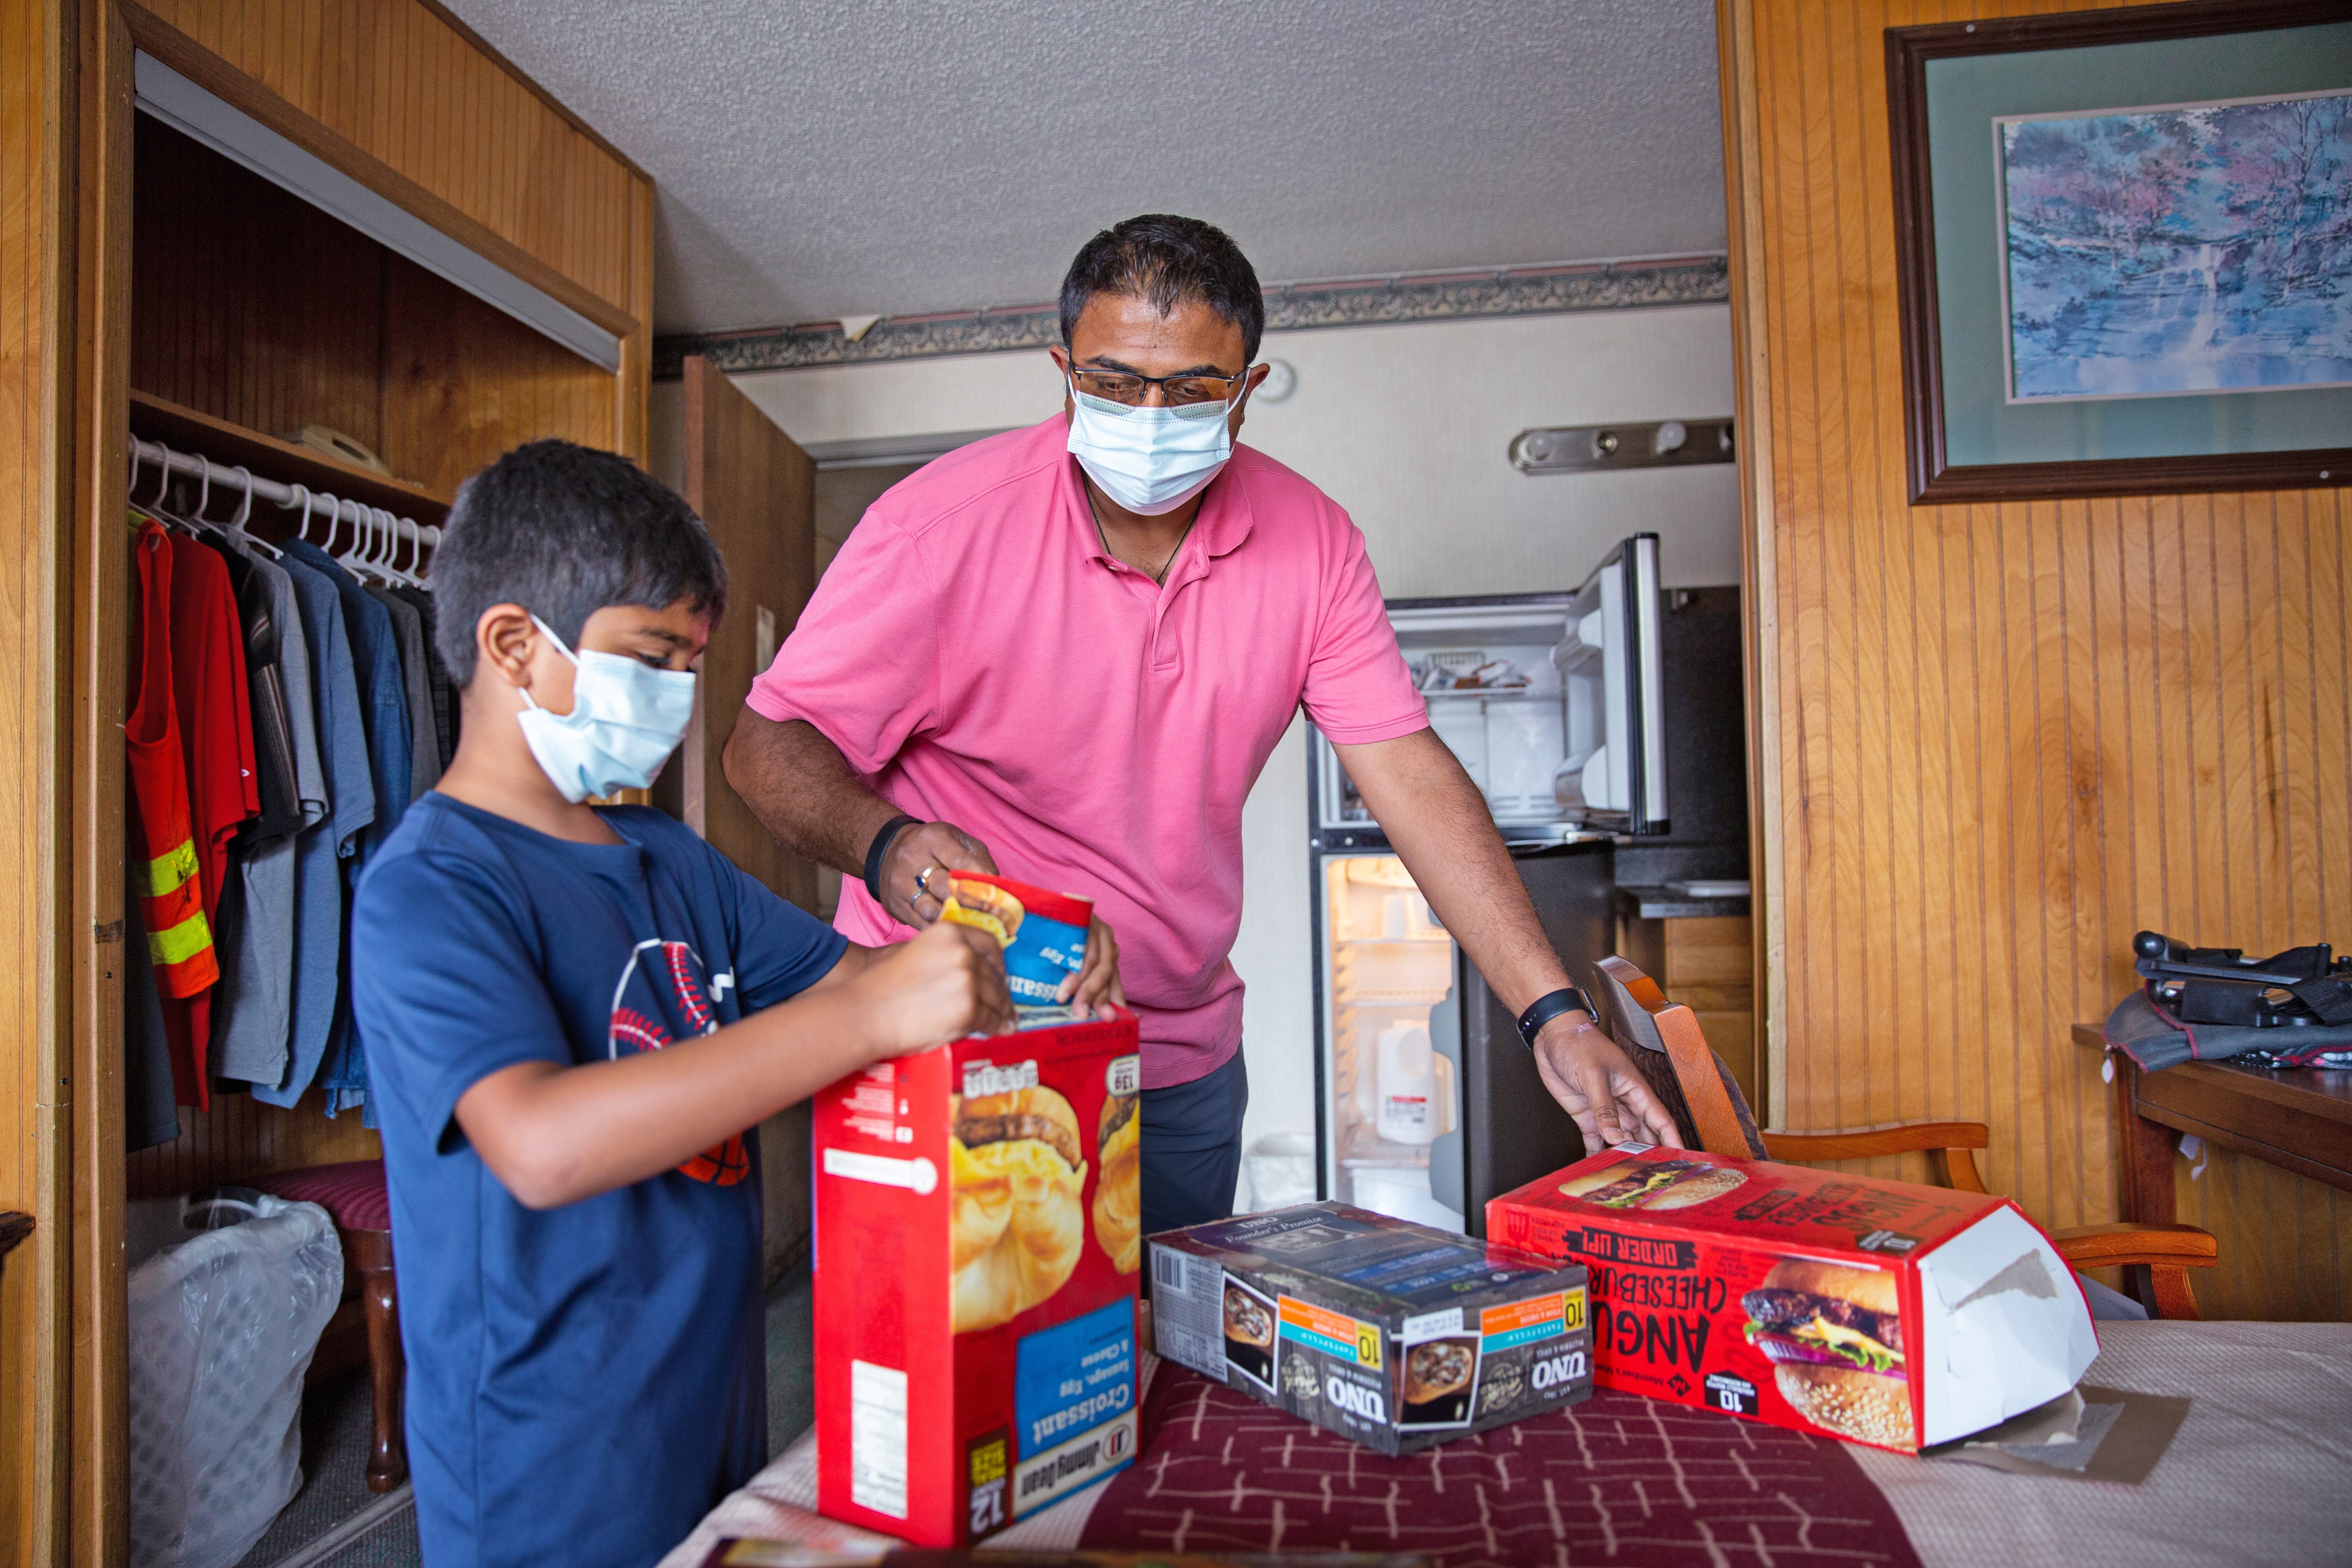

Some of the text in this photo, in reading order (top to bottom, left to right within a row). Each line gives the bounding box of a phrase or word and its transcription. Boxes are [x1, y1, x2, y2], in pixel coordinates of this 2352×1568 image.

[1225, 1216, 1323, 1243] Founder's Promise
[1237, 1216, 1278, 1228] UNO
[1582, 1230, 1612, 1256] UP!
[1617, 1236, 1677, 1267] ORDER
[1566, 1301, 1584, 1327] 10
[1359, 1336, 1379, 1363] 10
[1592, 1301, 1711, 1374] ANGU
[1532, 1351, 1586, 1390] UNO
[1594, 1364, 1664, 1387] Member's Mar
[1033, 1383, 1129, 1444] Croissant
[1326, 1376, 1388, 1425] UNO
[1720, 1390, 1742, 1413] 10
[970, 1489, 1006, 1533] 12
